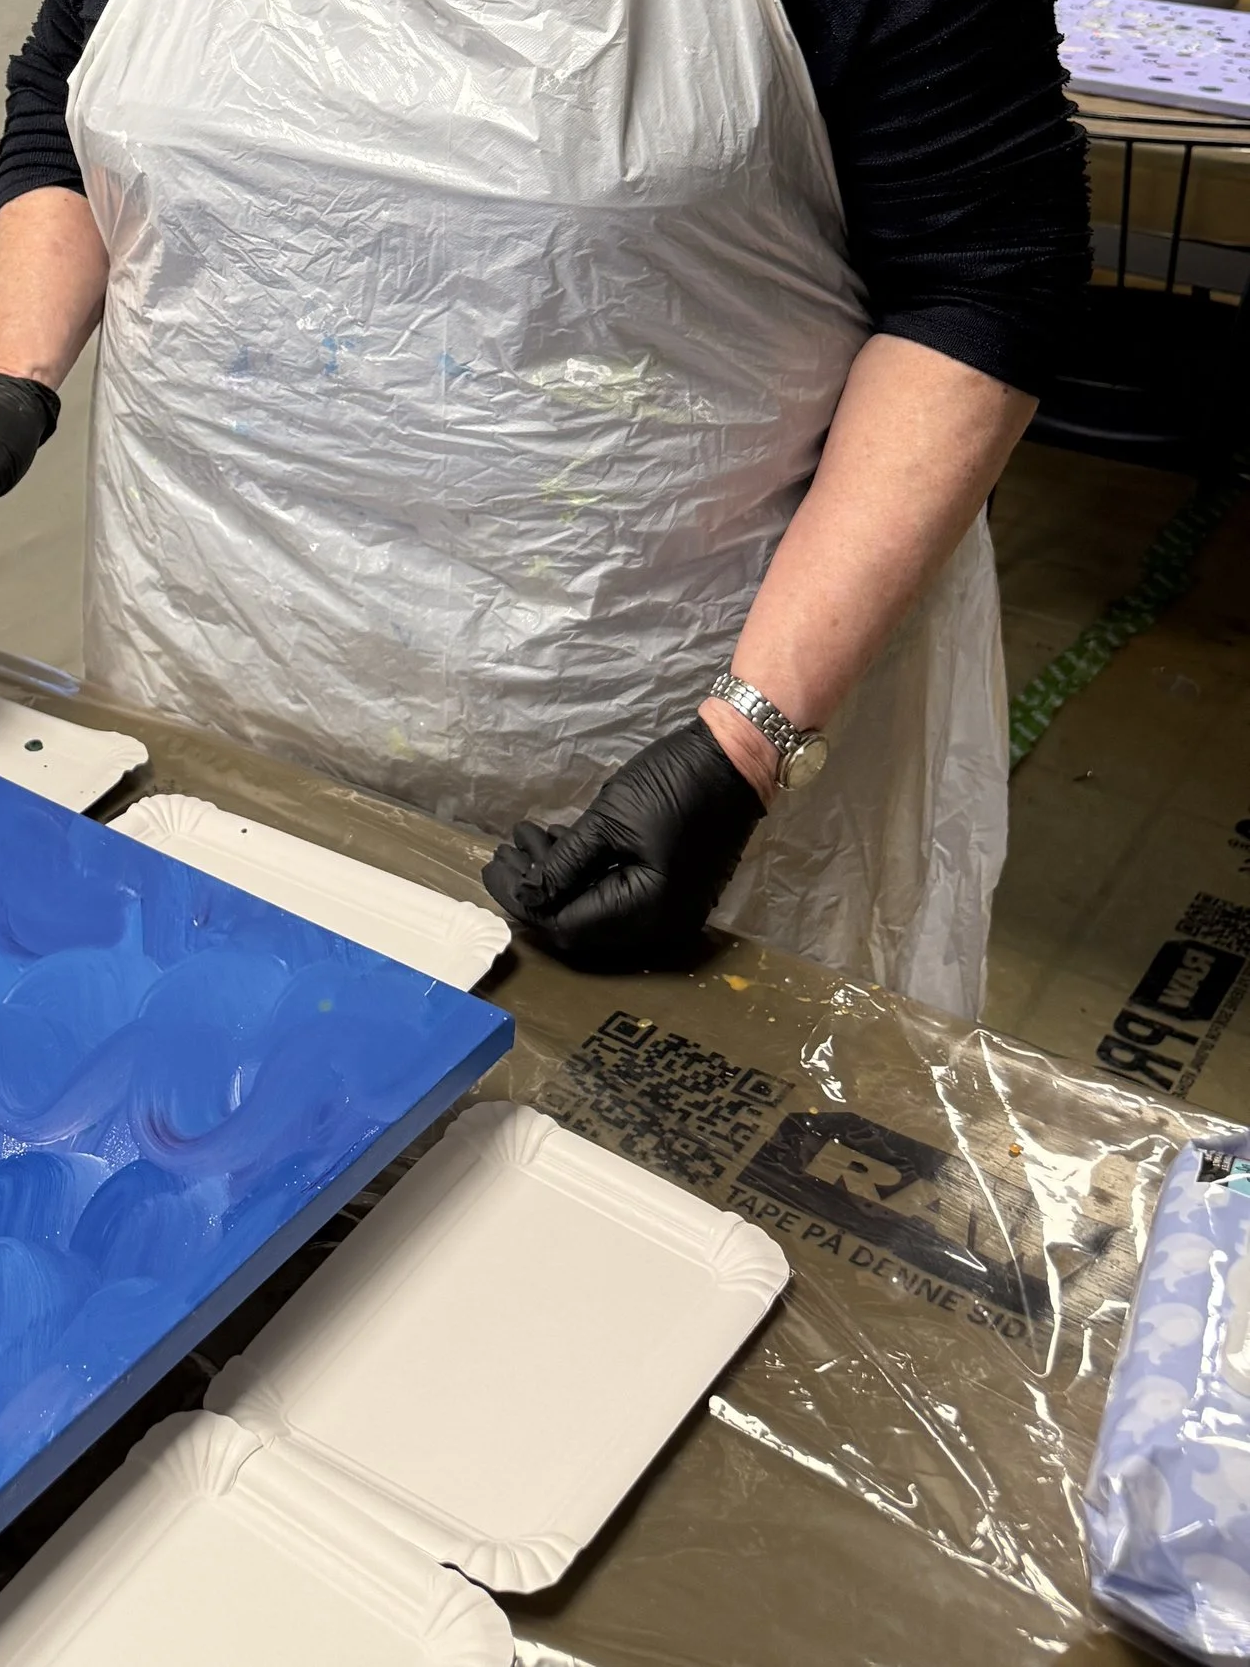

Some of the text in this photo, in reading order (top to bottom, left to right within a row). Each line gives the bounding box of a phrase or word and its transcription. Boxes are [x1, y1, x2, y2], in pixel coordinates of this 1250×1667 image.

[724, 1184, 1037, 1344] TAPE PÅ DENNE SID
